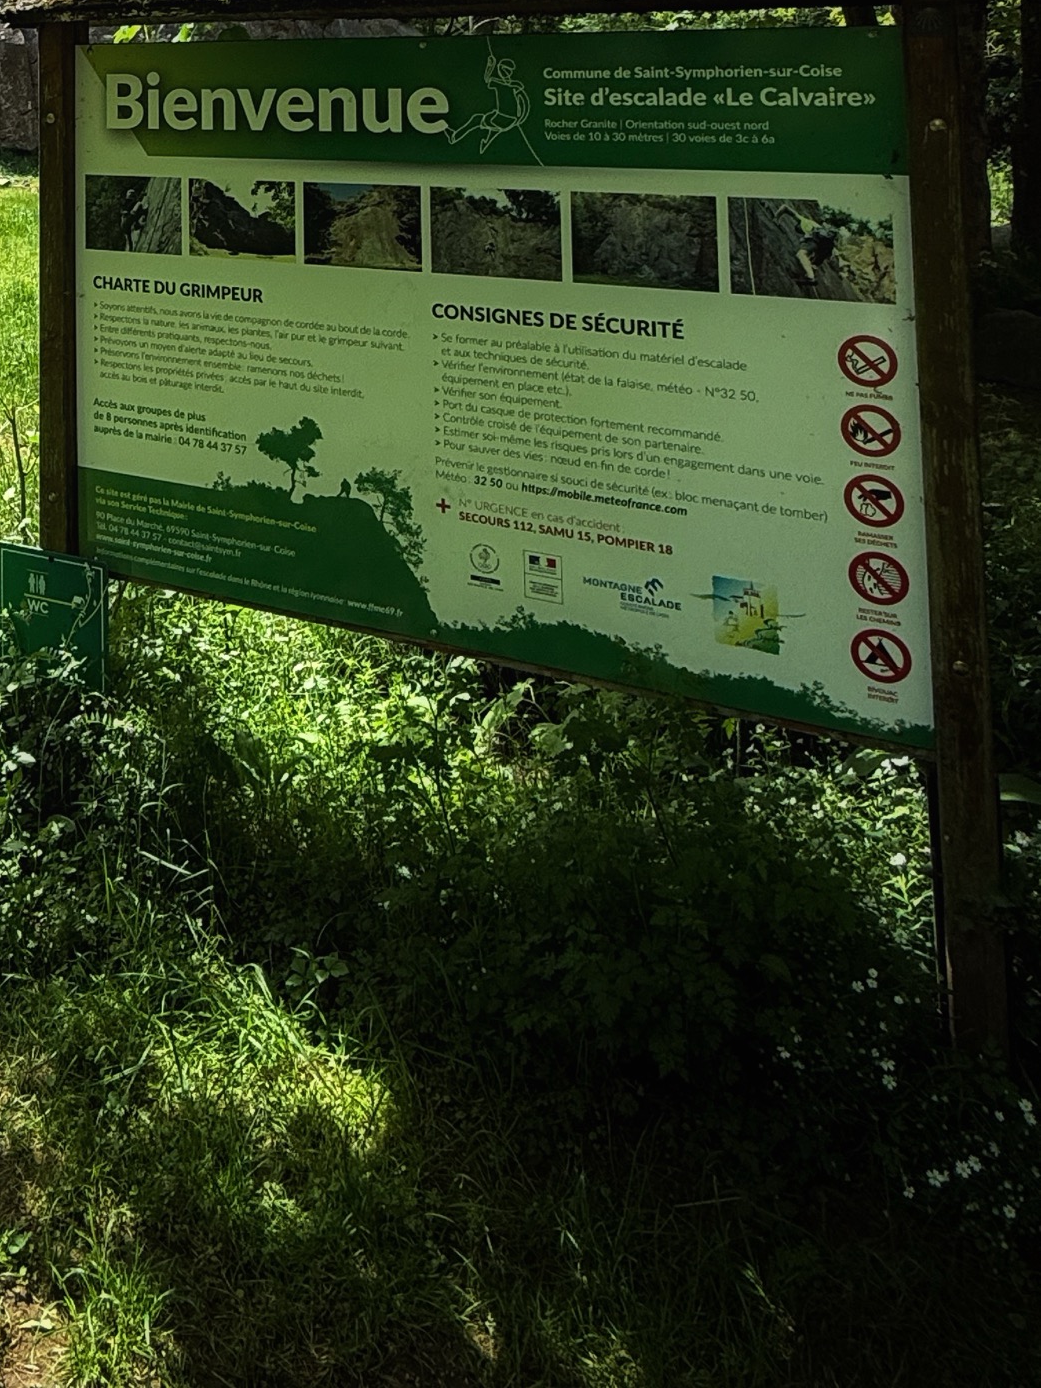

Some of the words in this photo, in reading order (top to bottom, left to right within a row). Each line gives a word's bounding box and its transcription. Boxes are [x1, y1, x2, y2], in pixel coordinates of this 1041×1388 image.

[543, 68, 610, 79] Commune
[614, 67, 631, 78] de
[635, 65, 842, 80] Saint-Symphorien-sur-Coise
[106, 71, 449, 134] Bienvenue
[544, 88, 585, 105] Site
[591, 87, 706, 106] d'escalade
[713, 88, 753, 106] «Le
[760, 87, 875, 106] Calvaire»
[545, 119, 578, 128] Rocher
[581, 119, 617, 128] Granite
[626, 120, 684, 129] Orientation
[687, 120, 741, 130] sud-ouest
[744, 121, 769, 130] nord
[544, 131, 571, 140] Voies
[573, 132, 585, 141] de
[589, 132, 601, 141] 10
[604, 132, 609, 141] à
[612, 132, 625, 141] 30
[672, 133, 686, 142] 30
[688, 133, 716, 143] voies
[719, 134, 733, 143] de
[736, 134, 749, 143] 3c
[752, 134, 758, 143] à
[761, 134, 774, 143] 6a
[93, 276, 150, 293] CHARTE
[154, 280, 176, 295] DU
[180, 283, 263, 303] GRIMPEUR
[432, 303, 544, 327] CONSIGNES
[550, 313, 577, 330] DE
[582, 313, 684, 339] SÉCURITÉ
[100, 324, 119, 334] Entre
[121, 326, 155, 337] différents
[157, 331, 202, 344] pratiquants,
[441, 333, 453, 343] Se
[455, 334, 488, 346] former
[506, 340, 551, 352] préalable
[554, 343, 559, 353] à
[563, 344, 619, 359] l'utilisation
[623, 350, 636, 360] du
[640, 353, 684, 365] matériel
[688, 356, 747, 371] d'escalade
[441, 347, 451, 356] et
[453, 350, 471, 358] aux
[473, 349, 527, 364] techniques
[530, 355, 543, 365] de
[546, 357, 589, 370] sécurité.
[100, 371, 120, 380] accès
[133, 373, 147, 383] bois
[149, 377, 157, 385] et
[159, 378, 192, 390] pâturage
[441, 359, 476, 371] Vérifier
[479, 363, 559, 380] l'environnement
[562, 371, 585, 383] (état
[588, 374, 601, 385] de
[605, 376, 613, 386] la
[616, 377, 653, 392] falaise,
[657, 383, 693, 395] météo
[442, 373, 500, 388] équipement
[518, 381, 544, 393] place
[442, 386, 477, 398] Vérifier
[479, 393, 496, 401] son
[93, 398, 118, 409] Accès
[119, 403, 135, 412] aux
[137, 406, 172, 417] groupes
[174, 409, 185, 419] de
[187, 411, 206, 422] plus
[443, 399, 463, 410] Port
[466, 402, 477, 412] du
[481, 406, 515, 417] casque
[518, 408, 530, 418] de
[534, 412, 587, 426] protection
[590, 417, 644, 432] fortement
[94, 410, 104, 420] de
[106, 412, 112, 421] 8
[114, 415, 157, 428] personnes
[159, 422, 183, 432] après
[186, 424, 246, 441] identification
[443, 413, 484, 426] Contrôle
[487, 420, 516, 430] croisé
[519, 422, 532, 432] de
[535, 423, 602, 441] l'équipement
[605, 433, 618, 443] de
[621, 437, 640, 446] son
[94, 426, 121, 436] auprès
[123, 428, 134, 438] de
[136, 429, 143, 439] la
[179, 436, 190, 446] 04
[193, 438, 204, 448] 78
[206, 441, 218, 451] 44
[220, 443, 232, 453] 37
[235, 445, 247, 455] 57
[444, 439, 466, 451] Pour
[468, 445, 500, 455] sauver
[503, 447, 520, 458] des
[551, 456, 581, 467] nœud
[584, 461, 597, 469] en
[600, 460, 614, 471] fin
[618, 463, 631, 474] de
[436, 456, 474, 470] Prévenir
[477, 462, 485, 472] le
[487, 466, 547, 481] gestionnaire
[550, 473, 558, 483] si
[561, 477, 587, 487] souci
[591, 478, 604, 489] de
[607, 481, 649, 496] sécurité
[675, 490, 698, 503] bloc
[702, 496, 758, 512] menaçant
[762, 503, 776, 514] de
[780, 505, 828, 523] tomber)
[474, 475, 487, 486] 32
[490, 478, 503, 488] 50
[506, 483, 518, 491] ou
[521, 482, 687, 516] https://mobile.meteofrance.com
[475, 500, 528, 518] URGENCE
[531, 512, 544, 520] en
[547, 514, 563, 523] cas
[459, 511, 510, 528] SECOURS
[513, 520, 536, 534] 112,
[538, 524, 574, 538] SAMU
[577, 531, 594, 544] 15,
[597, 533, 655, 552] POMPIER
[658, 544, 673, 555] 18
[582, 576, 643, 594] MONTAGNE
[27, 598, 49, 614] WC
[620, 592, 682, 611] ESCALADE
